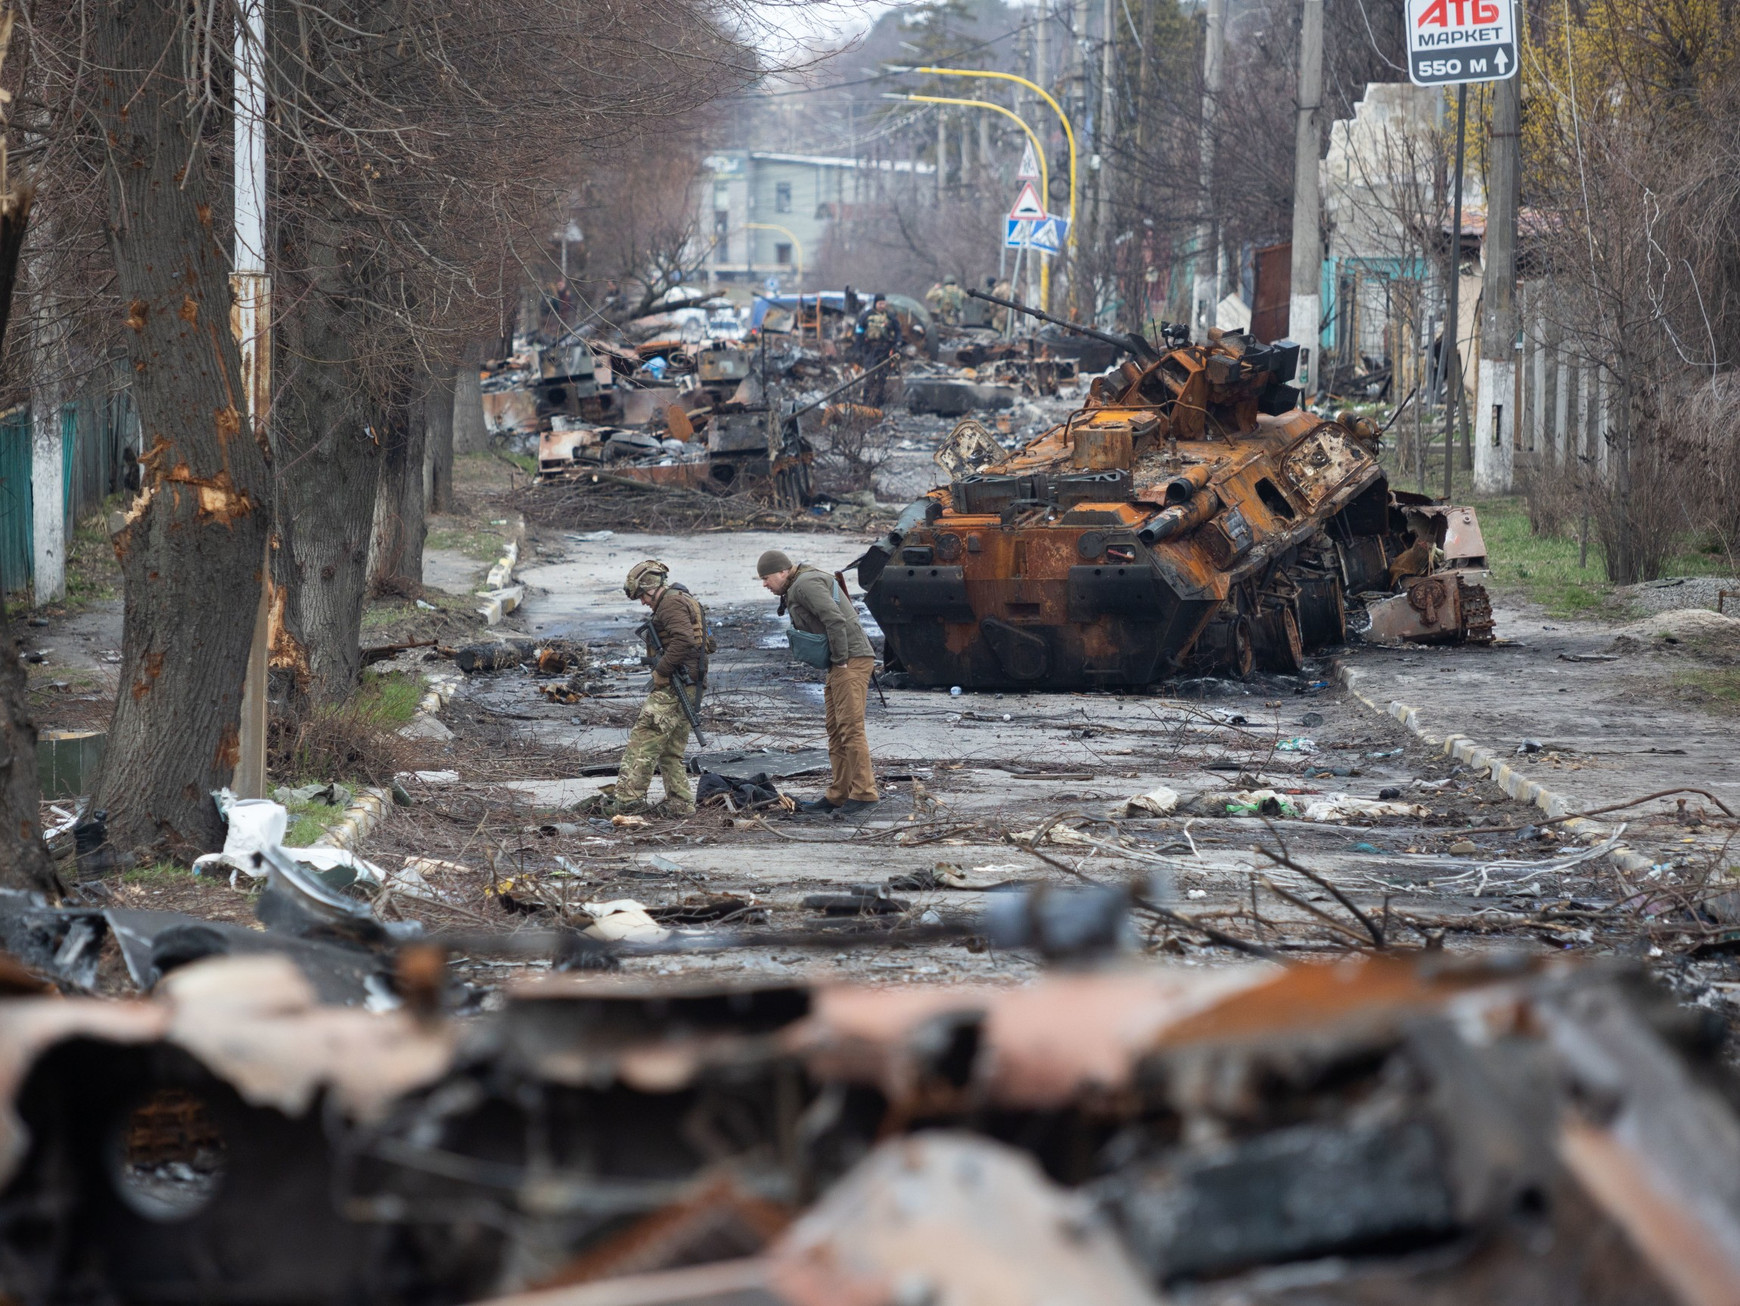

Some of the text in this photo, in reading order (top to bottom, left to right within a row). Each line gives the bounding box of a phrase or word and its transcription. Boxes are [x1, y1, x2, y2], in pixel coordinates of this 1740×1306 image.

[1418, 0, 1499, 28] АТБ
[1419, 27, 1503, 47] МАРКЕТ
[1419, 59, 1462, 76] 550
